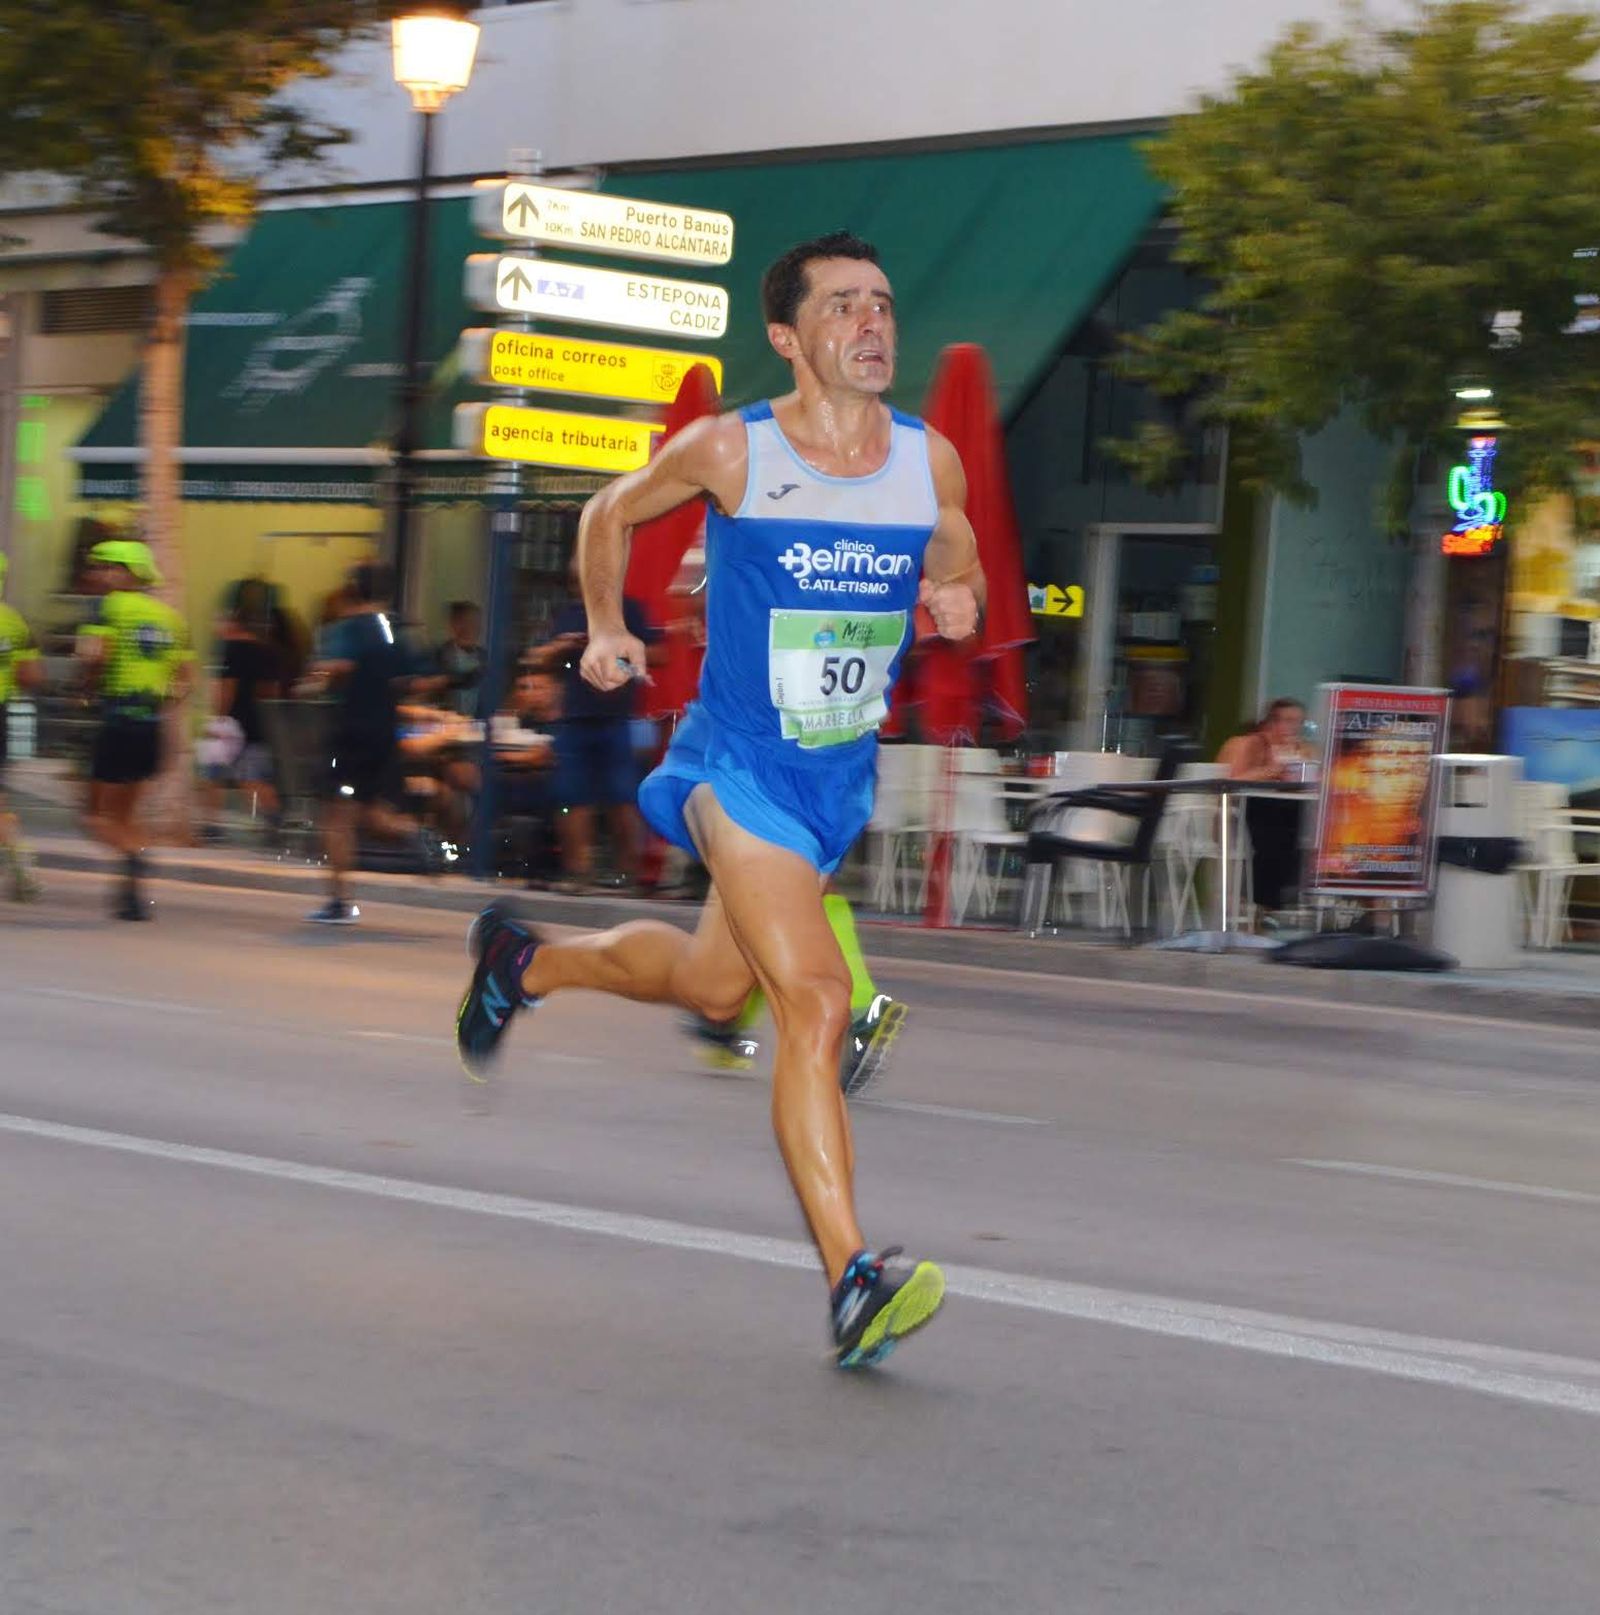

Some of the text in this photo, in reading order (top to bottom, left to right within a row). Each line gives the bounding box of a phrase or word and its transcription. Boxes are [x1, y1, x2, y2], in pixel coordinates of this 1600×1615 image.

[625, 206, 677, 229] Puerto
[544, 222, 573, 237] 10Km
[580, 221, 606, 240] SAN
[610, 226, 651, 247] PEDRO
[626, 281, 722, 310] ESTEPONA
[669, 309, 721, 332] CADIZ
[496, 339, 627, 368] oficina correos
[493, 363, 565, 382] post office
[491, 423, 638, 452] agencia tributaria
[834, 539, 875, 552] clínica
[798, 577, 889, 595] C.ATLETISMO
[820, 656, 866, 696] 50
